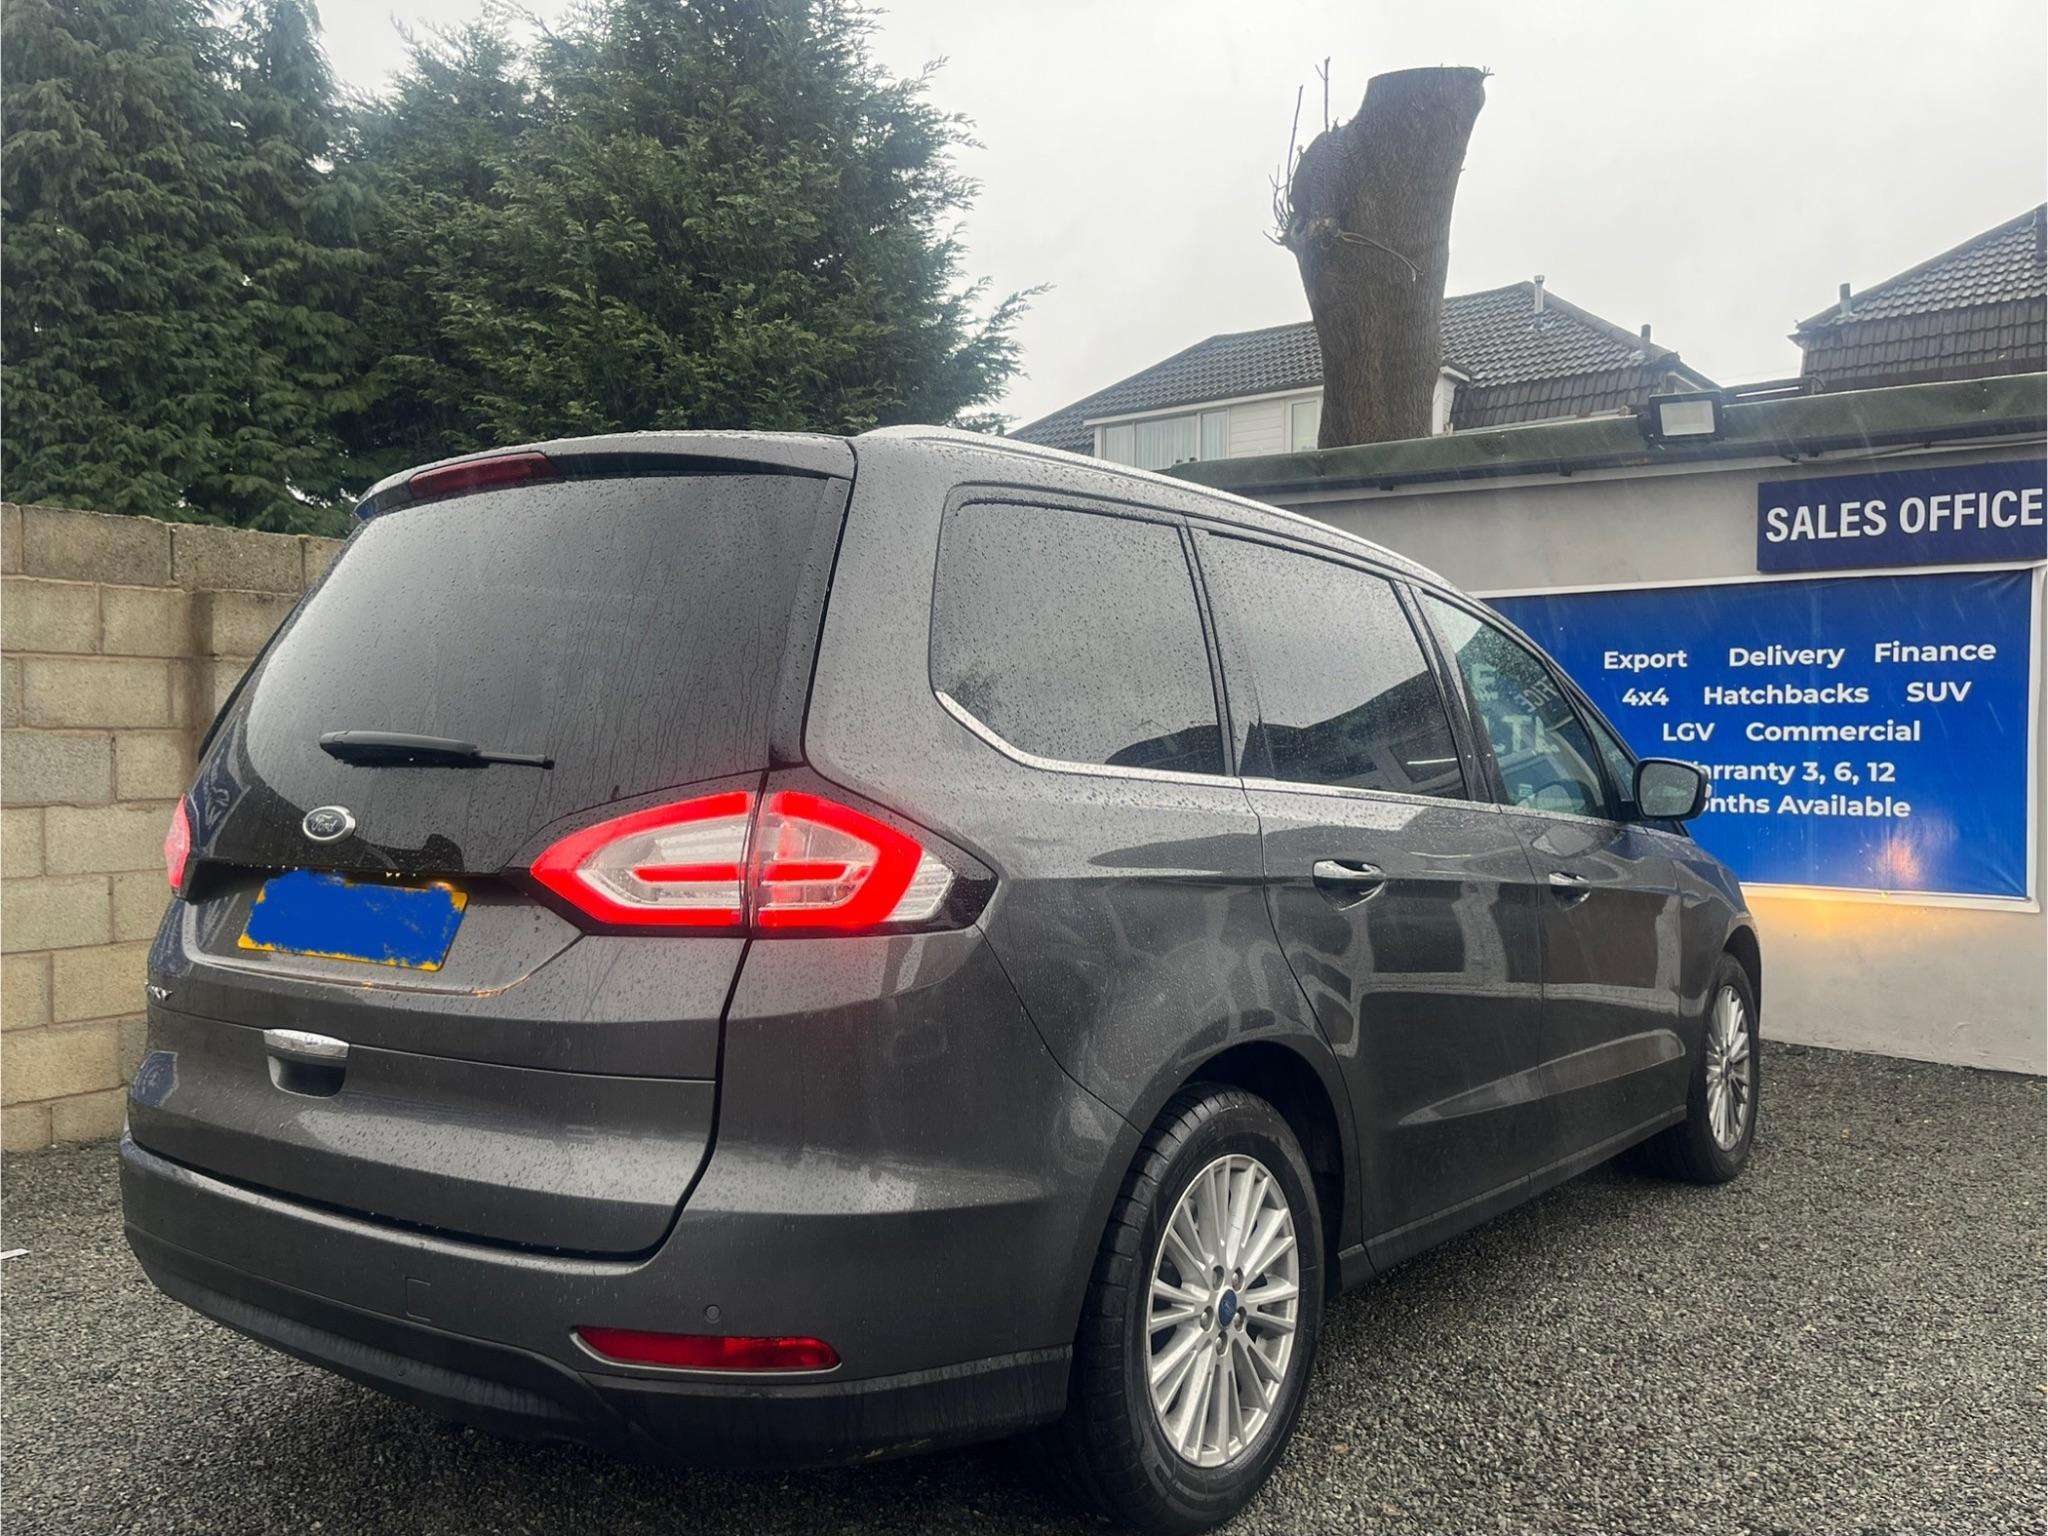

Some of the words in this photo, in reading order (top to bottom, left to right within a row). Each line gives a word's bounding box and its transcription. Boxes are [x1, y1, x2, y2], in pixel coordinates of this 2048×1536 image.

[1766, 500, 1887, 543] SALES
[1899, 488, 2043, 534] OFFICE
[1603, 649, 1688, 672] Export
[1728, 645, 1845, 669] Delivery
[1874, 642, 1997, 664] Finance
[1622, 687, 1669, 706] 4x4
[1703, 684, 1869, 706] Hatchbacks
[1906, 681, 1972, 702] SUV
[1663, 722, 1714, 742] LGV
[1745, 720, 1921, 743] Commercial
[1684, 762, 1792, 785] rranty
[1802, 762, 1826, 785] 3,
[1834, 763, 1859, 785] 6,
[1867, 763, 1896, 783] 12
[1777, 796, 1911, 819] Available
